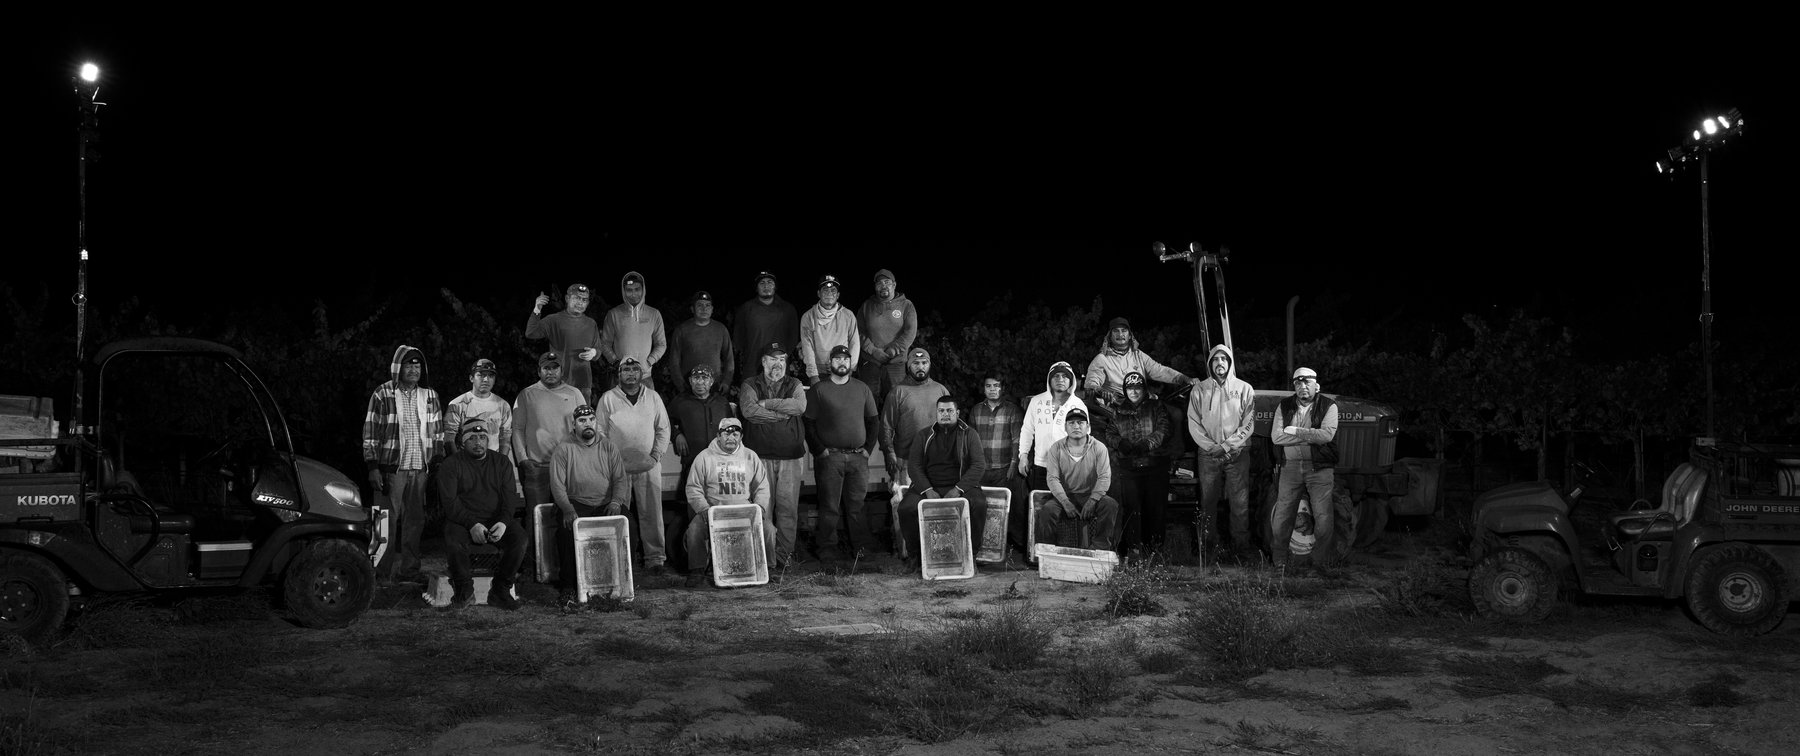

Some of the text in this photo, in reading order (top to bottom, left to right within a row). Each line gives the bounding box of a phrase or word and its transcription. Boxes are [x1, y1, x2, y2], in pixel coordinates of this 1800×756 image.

[1257, 411, 1274, 419] DEE
[1355, 412, 1362, 420] N
[17, 495, 77, 506] KUBOTA
[1725, 504, 1799, 513] JOHN DEERE
